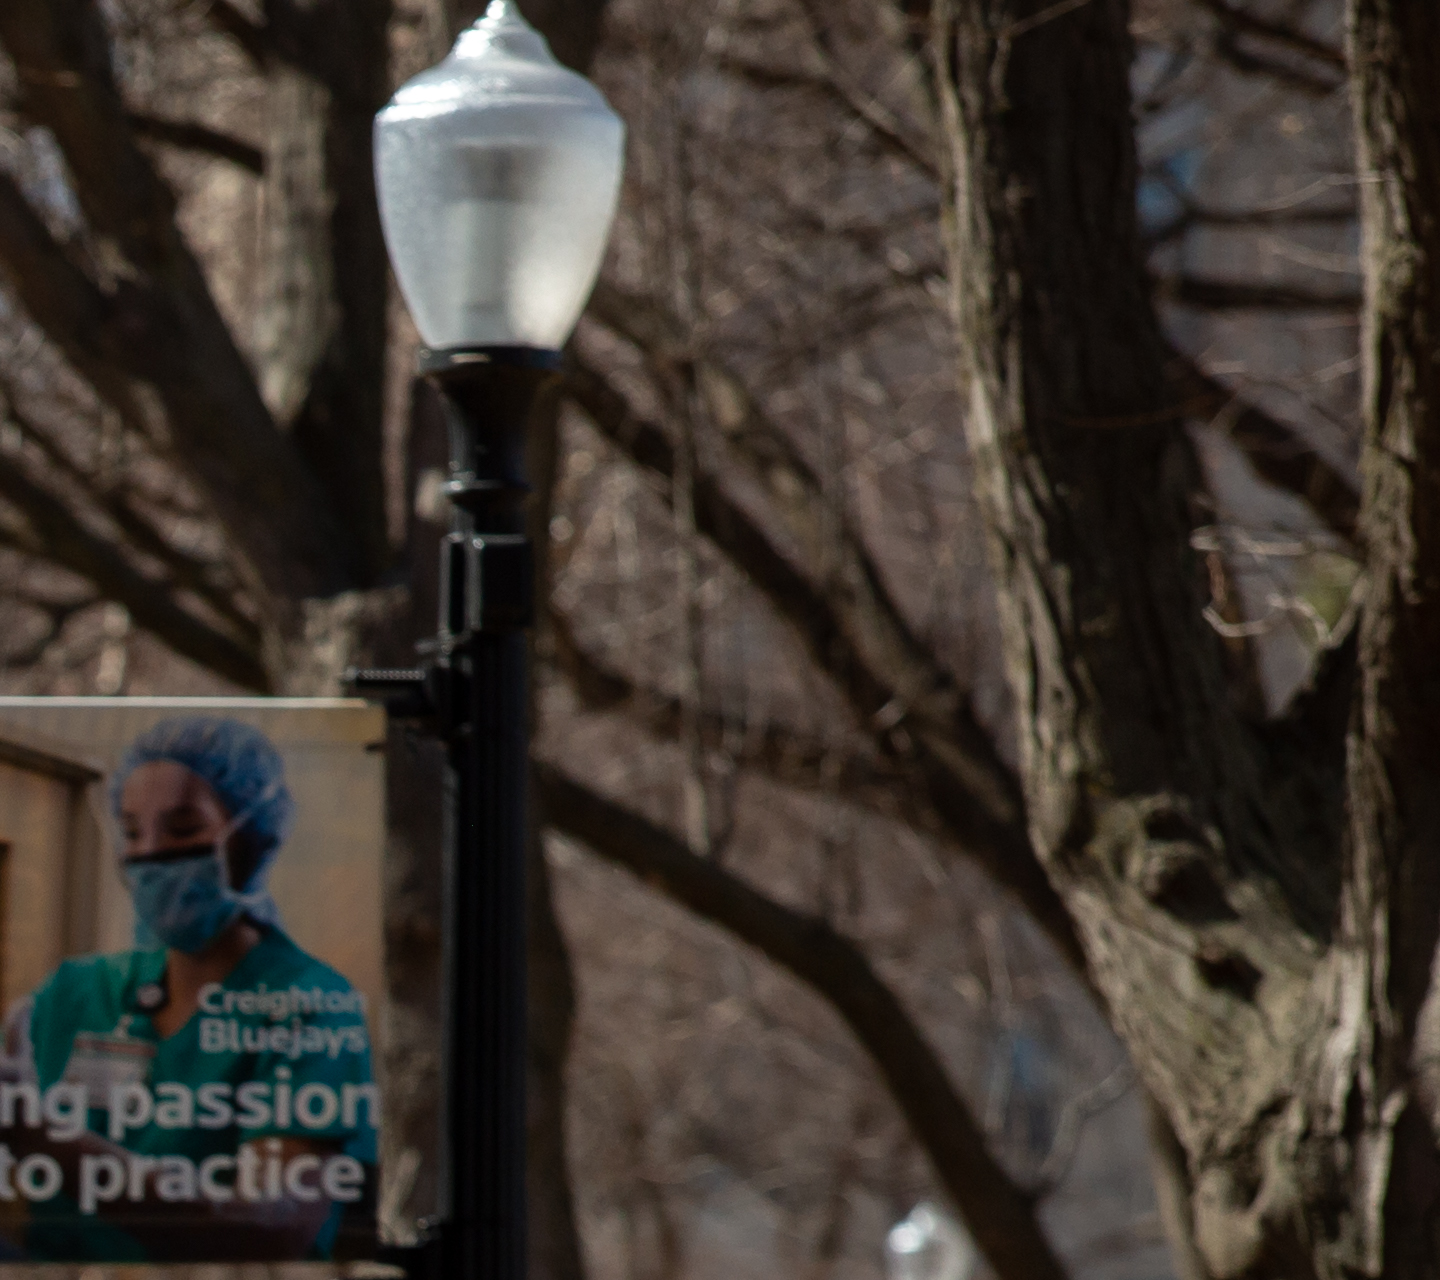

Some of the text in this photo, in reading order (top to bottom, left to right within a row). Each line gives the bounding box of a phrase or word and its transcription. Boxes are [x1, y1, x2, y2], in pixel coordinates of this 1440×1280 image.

[197, 983, 368, 1029] Creighton
[198, 1016, 367, 1060] Bluejays
[108, 1067, 380, 1138] passion
[80, 1141, 367, 1214] practice
